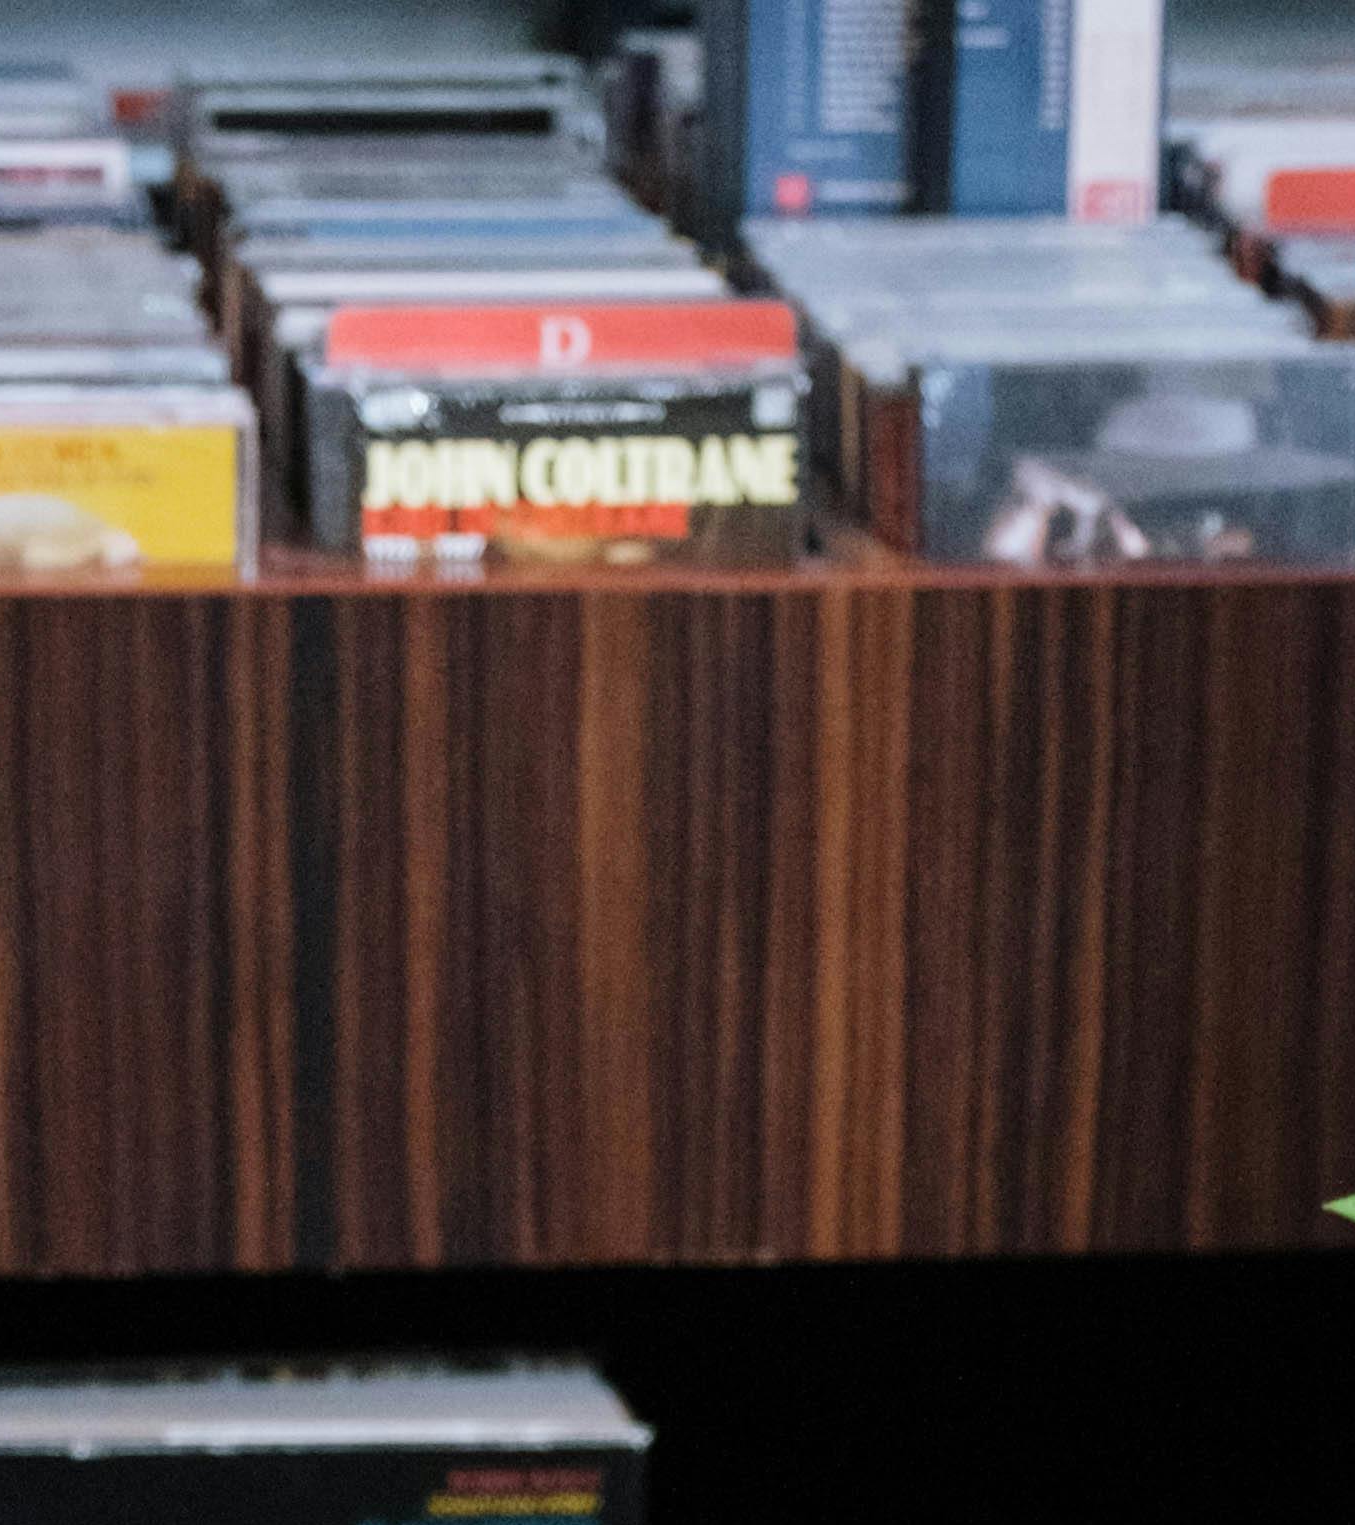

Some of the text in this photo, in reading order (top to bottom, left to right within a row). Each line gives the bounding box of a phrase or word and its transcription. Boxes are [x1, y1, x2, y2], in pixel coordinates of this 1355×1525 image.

[540, 316, 592, 367] D
[366, 436, 798, 507] JOHN COLTRANE
